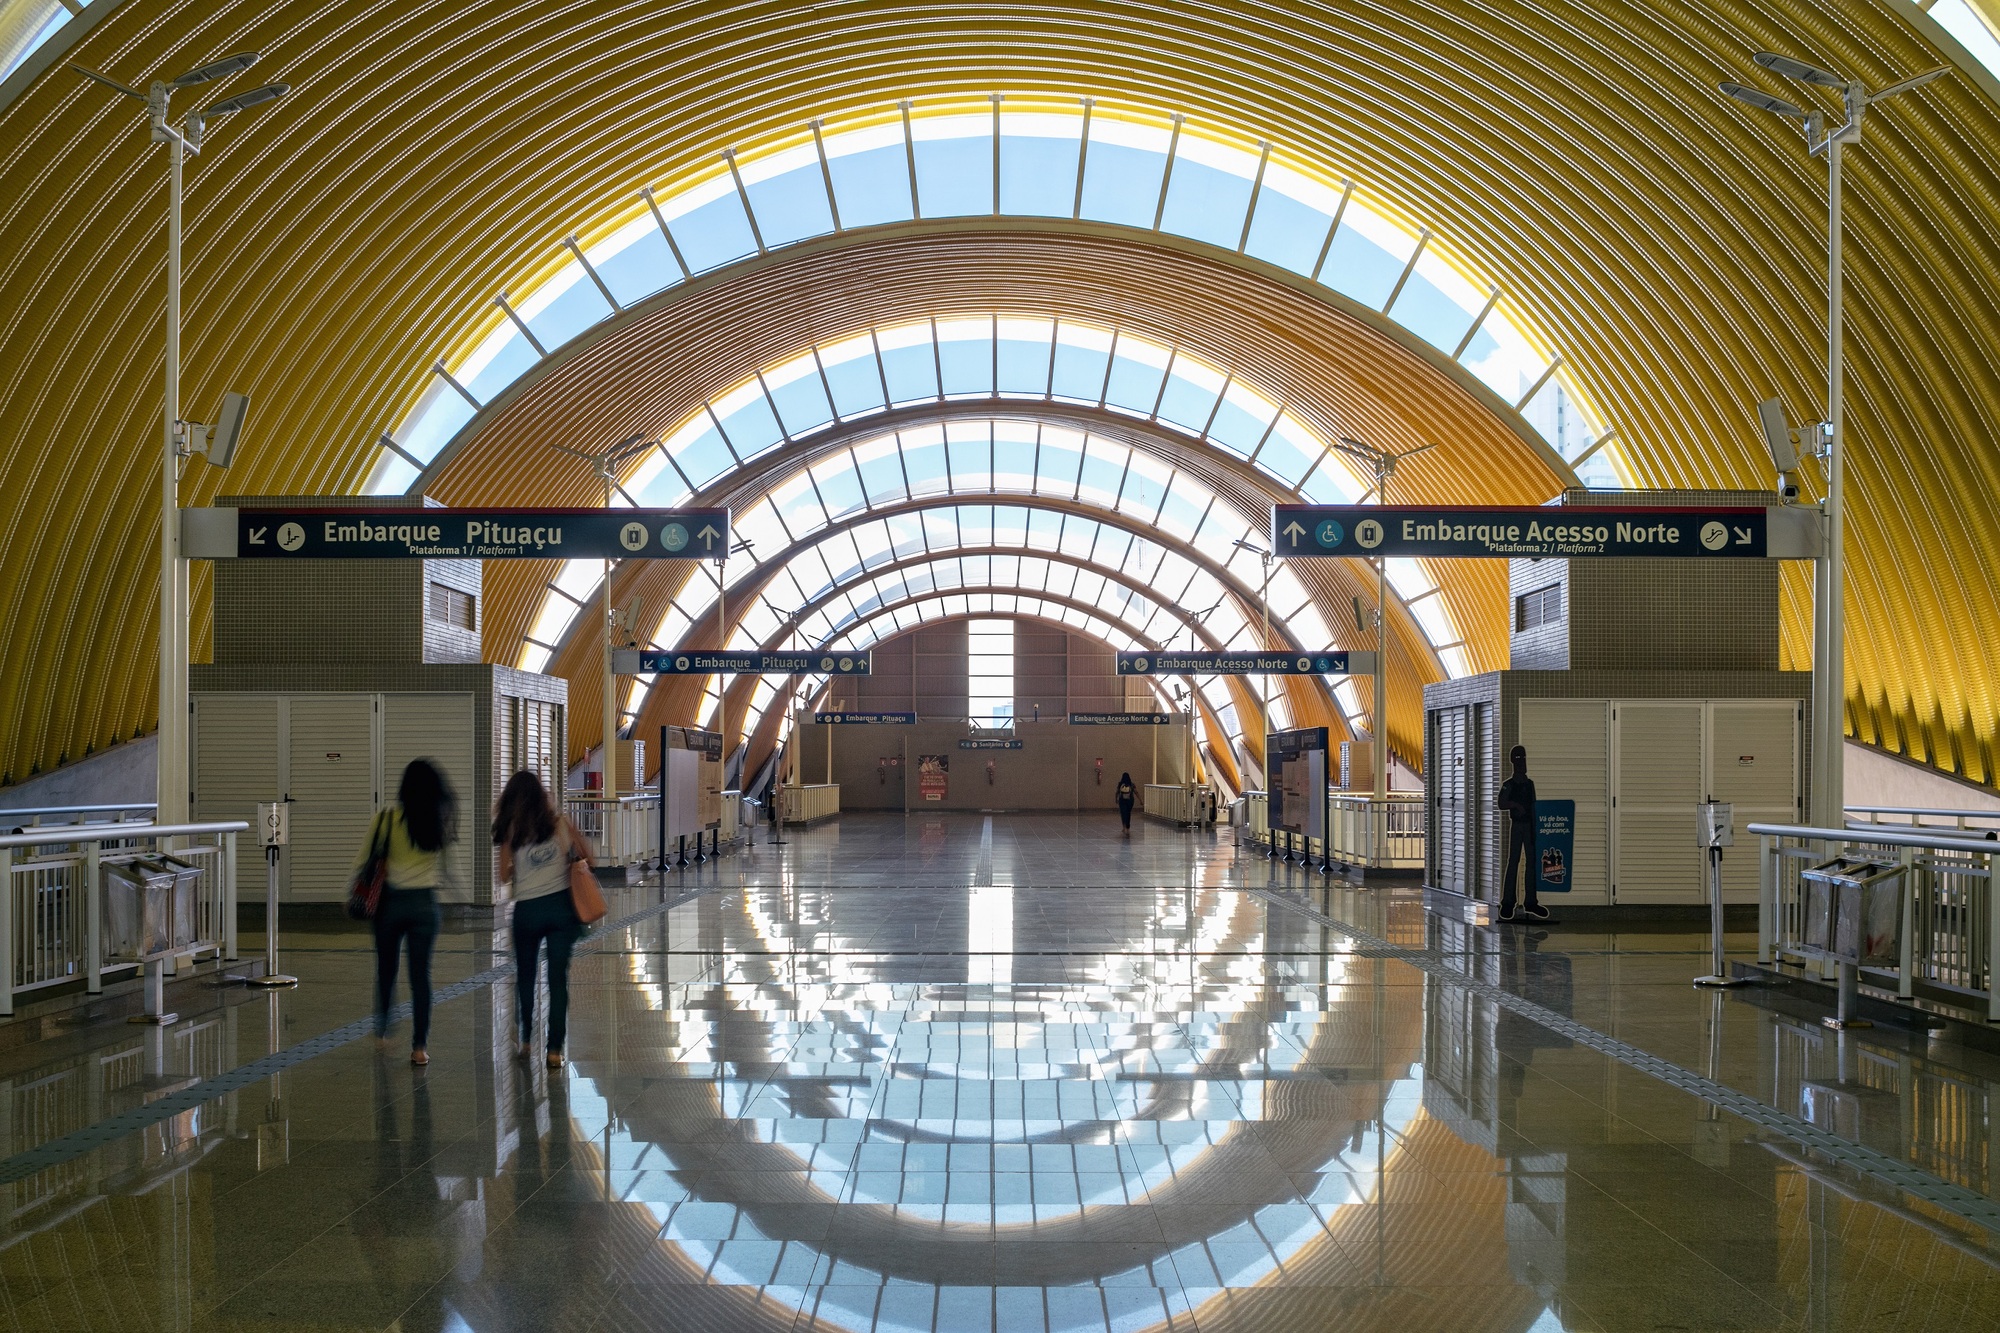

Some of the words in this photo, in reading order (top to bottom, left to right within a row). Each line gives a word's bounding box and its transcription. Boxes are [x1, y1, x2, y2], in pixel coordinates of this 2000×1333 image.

[324, 521, 441, 546] Embarque
[466, 521, 562, 550] Pituaçu
[1402, 519, 1520, 546] Embarque
[1526, 520, 1609, 543] Acesso
[1616, 522, 1680, 543] Norte
[409, 545, 461, 555] Plataforma
[476, 545, 518, 555] Platform
[1490, 542, 1541, 554] Plataforma
[1542, 542, 1548, 553] 2
[1557, 542, 1597, 554] Platform
[1598, 543, 1605, 553] 2
[695, 657, 751, 670] Embarque
[762, 656, 808, 670] Pituaçu
[1156, 658, 1212, 670] Embarque
[1215, 658, 1254, 669] Acesso
[1257, 658, 1288, 669] Norte
[882, 715, 906, 723] Pituaçu
[979, 741, 1004, 749] Sanitários
